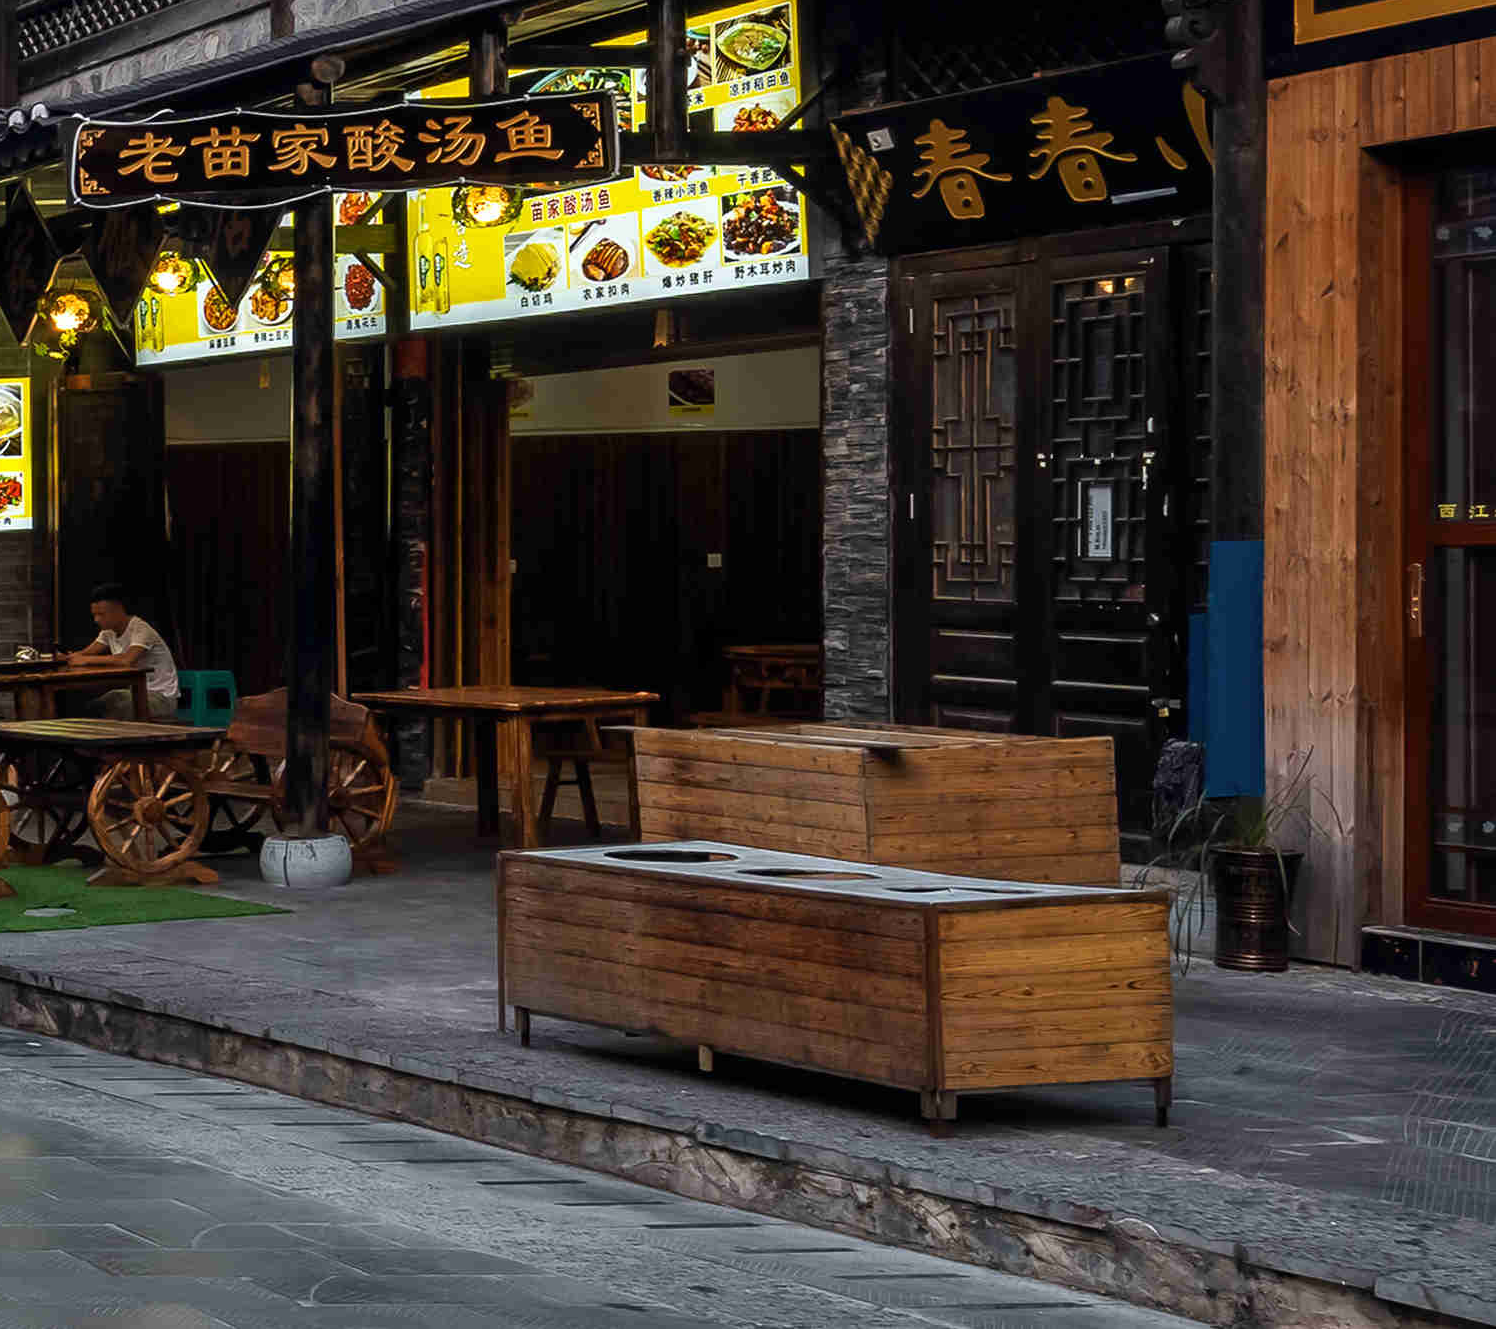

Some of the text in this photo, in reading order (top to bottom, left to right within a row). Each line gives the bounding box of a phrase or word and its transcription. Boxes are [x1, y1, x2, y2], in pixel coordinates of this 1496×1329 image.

[116, 108, 565, 187] 老苗家酸汤鱼
[530, 188, 611, 222] 苗家酸汤鱼
[734, 260, 797, 279] 野木耳炒肉
[583, 283, 630, 301] 农家扣肉
[1437, 503, 1496, 520] 西江
